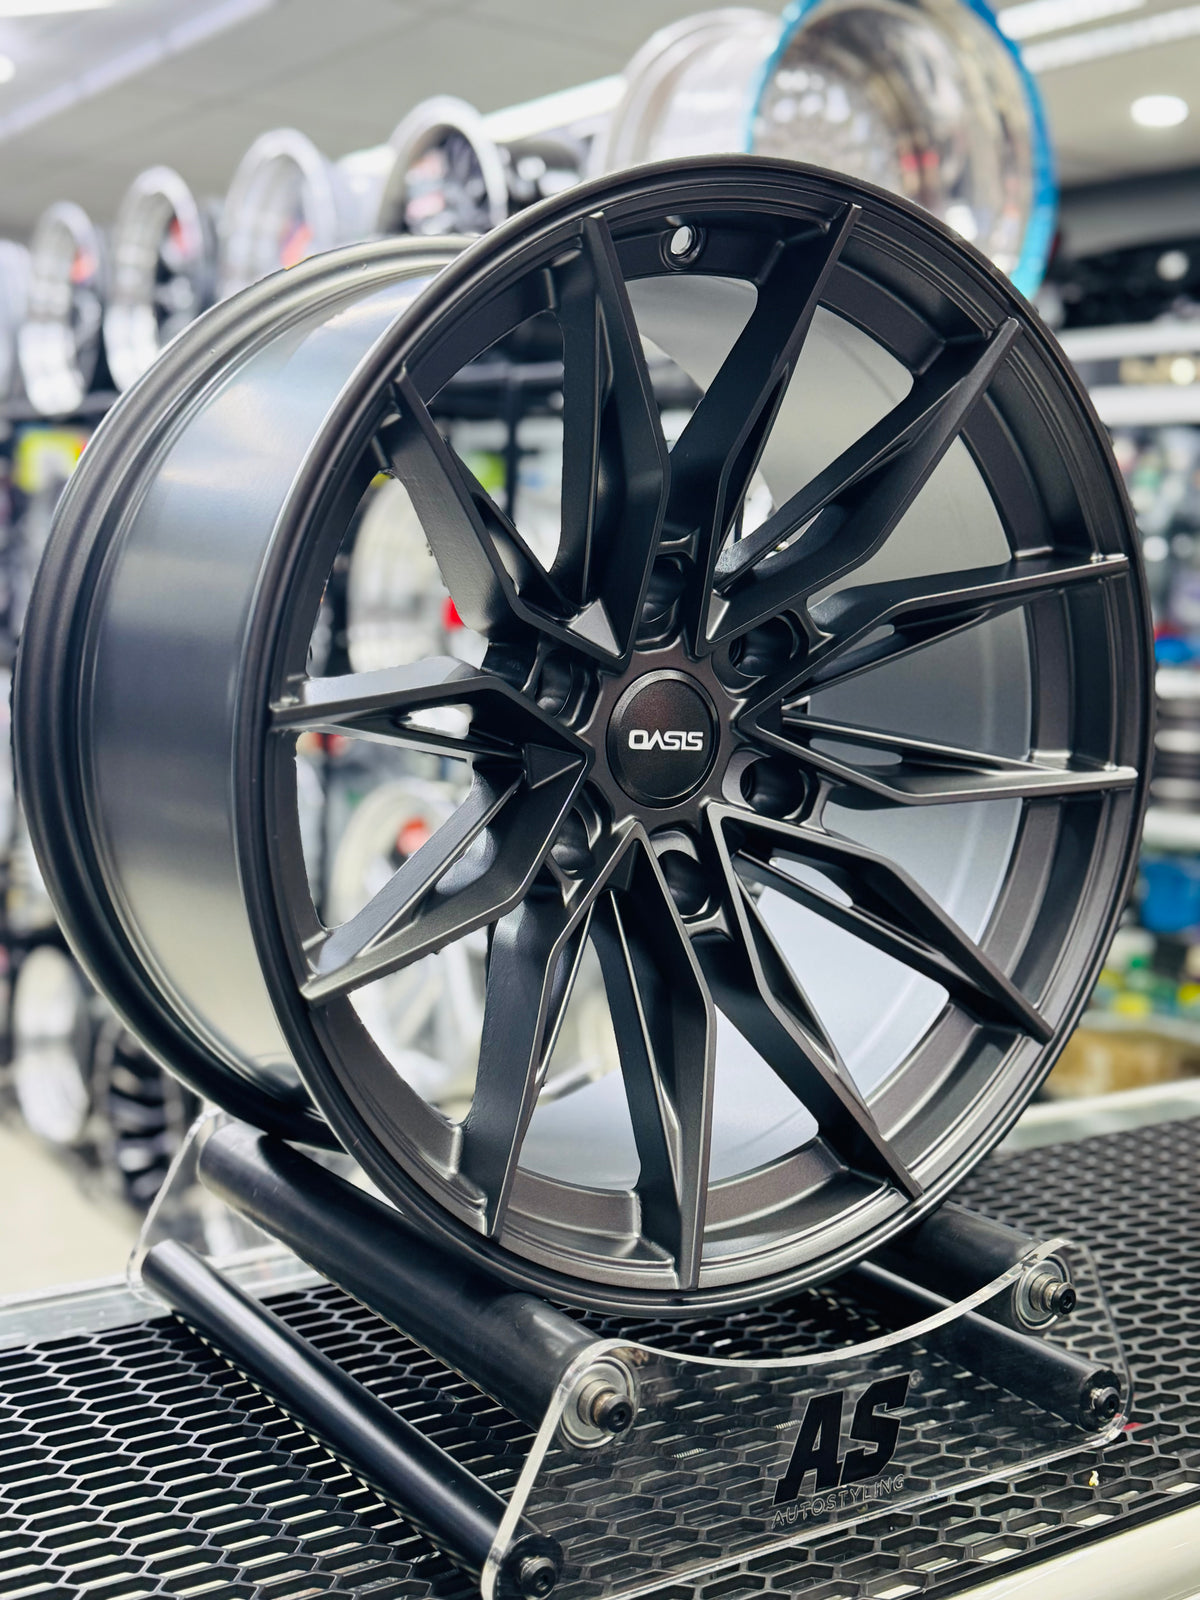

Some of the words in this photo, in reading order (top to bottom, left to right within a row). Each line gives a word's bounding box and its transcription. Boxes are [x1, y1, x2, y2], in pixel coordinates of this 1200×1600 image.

[628, 729, 704, 751] OASIS
[773, 1373, 911, 1506] AS
[771, 1473, 905, 1530] AUTOSTYLING
